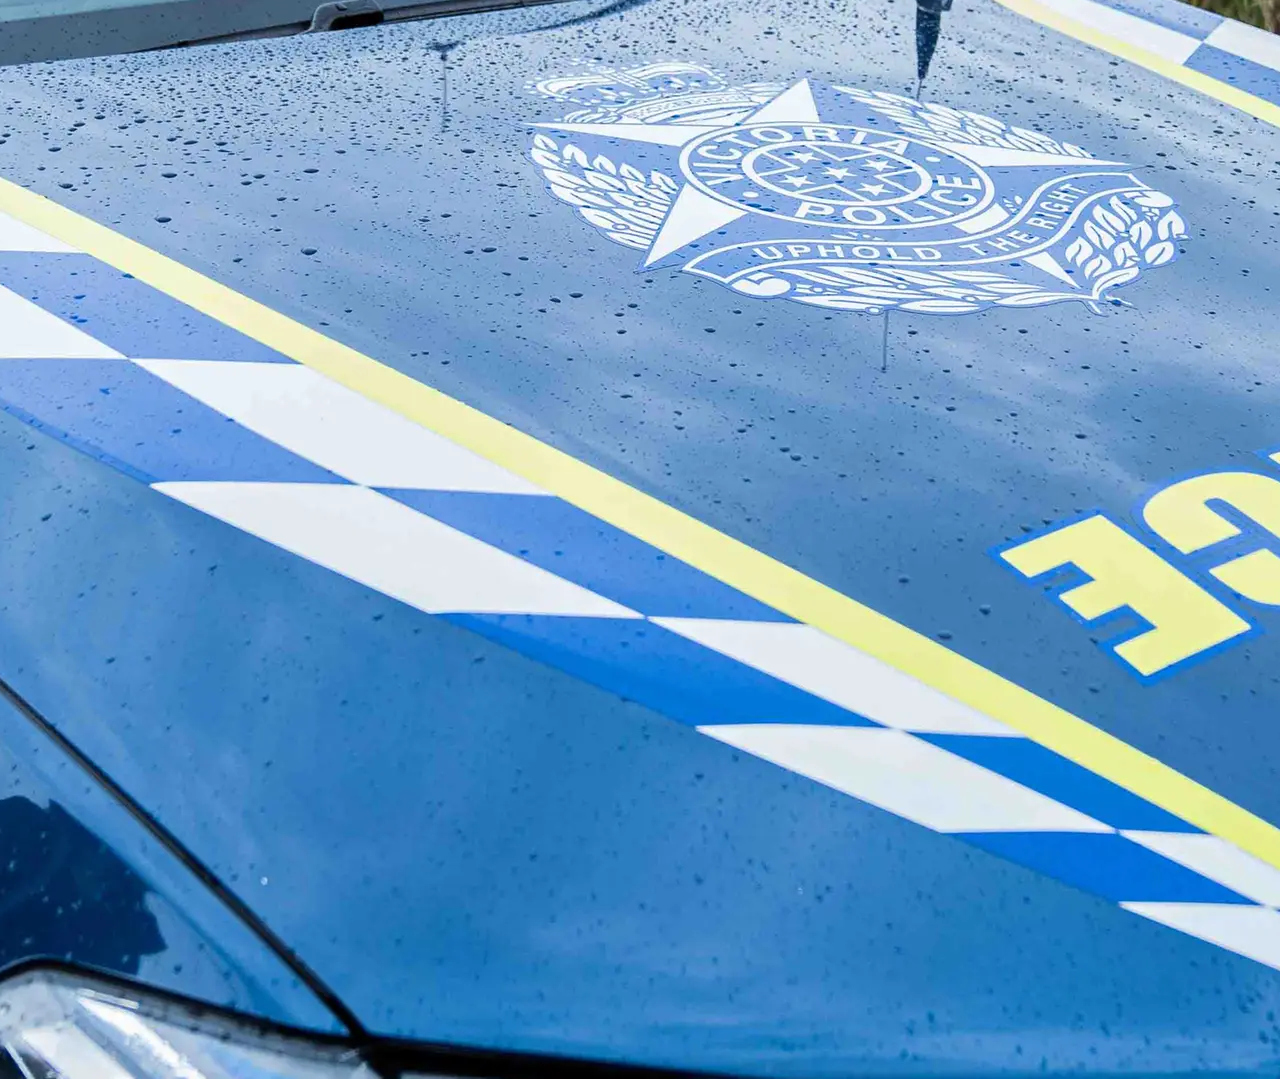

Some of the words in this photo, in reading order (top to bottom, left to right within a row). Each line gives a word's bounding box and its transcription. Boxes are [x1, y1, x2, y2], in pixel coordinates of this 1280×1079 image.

[691, 126, 910, 186] VICTORIA
[752, 242, 943, 262] UPHOLD
[958, 228, 1040, 256] THE
[1036, 182, 1088, 231] RIGHT
[793, 174, 983, 226] POLICE
